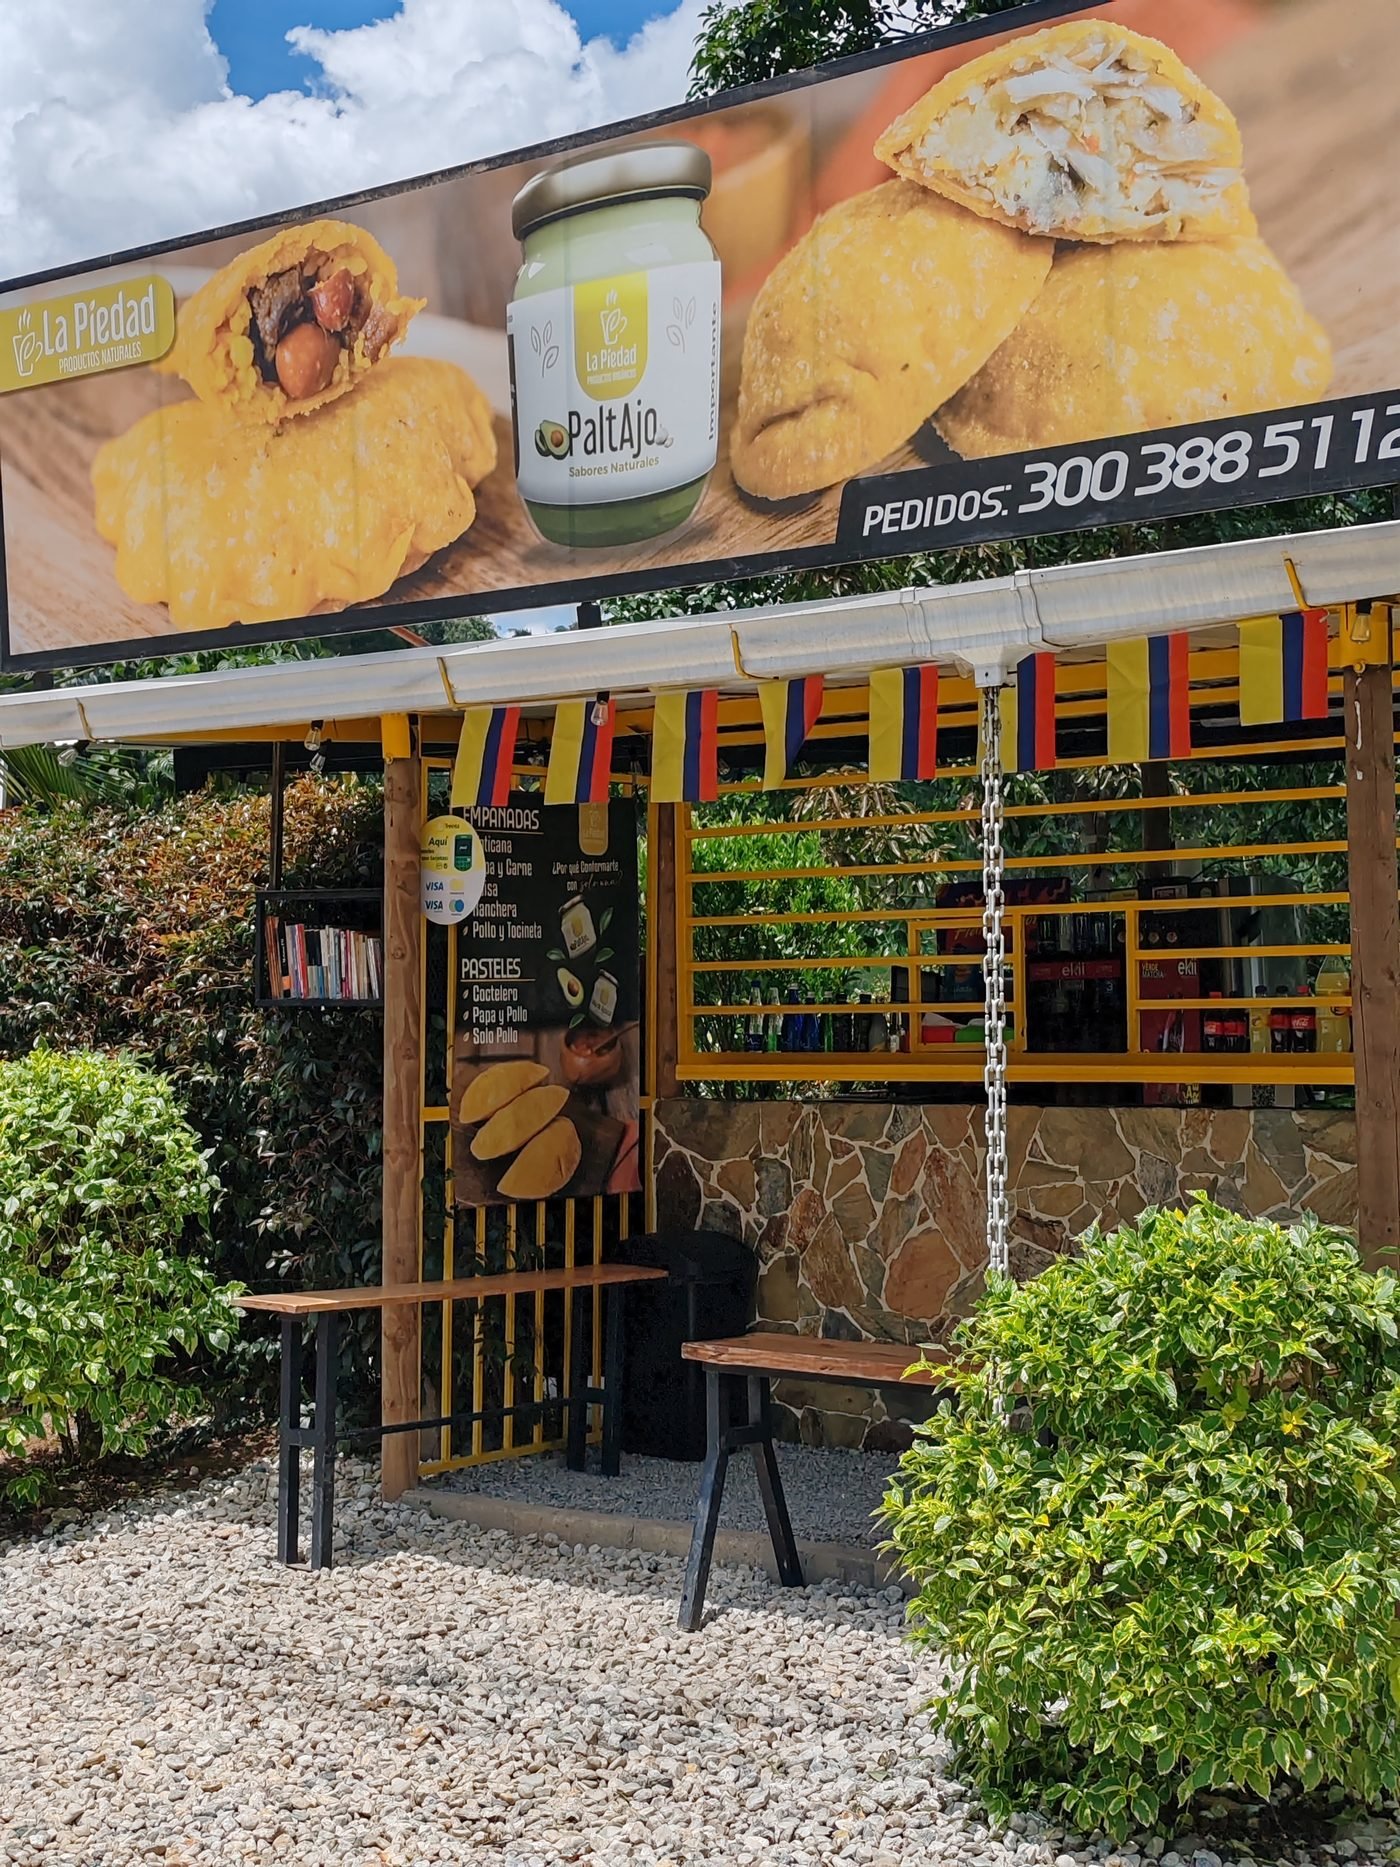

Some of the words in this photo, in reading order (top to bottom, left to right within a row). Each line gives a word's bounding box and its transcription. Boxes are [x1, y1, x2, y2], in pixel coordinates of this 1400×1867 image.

[43, 309, 68, 356] La
[59, 351, 100, 374] PRODUCTOS
[101, 341, 142, 364] NATURALES
[586, 351, 598, 372] La
[708, 301, 717, 441] Importante
[568, 399, 657, 459] PaltAjo
[568, 465, 608, 478] Sabores
[610, 456, 660, 474] Naturales
[862, 484, 1013, 537] PEDIDOS:
[1018, 450, 1129, 514] 300
[1134, 430, 1253, 497] 388
[497, 861, 504, 878] y
[505, 858, 533, 876] Carne
[425, 881, 444, 891] VISA
[566, 881, 578, 891] con
[425, 900, 444, 910] VISA
[472, 921, 497, 939] Pollo
[498, 924, 505, 942] y
[506, 921, 542, 939] Tocineta
[461, 957, 521, 979] PASTELES
[472, 984, 518, 1003] Coctelero
[472, 1006, 497, 1026] Papa
[498, 1009, 505, 1026] y
[506, 1005, 528, 1022] Pollo
[472, 1026, 494, 1045] Solo
[496, 1026, 518, 1044] Pollo
